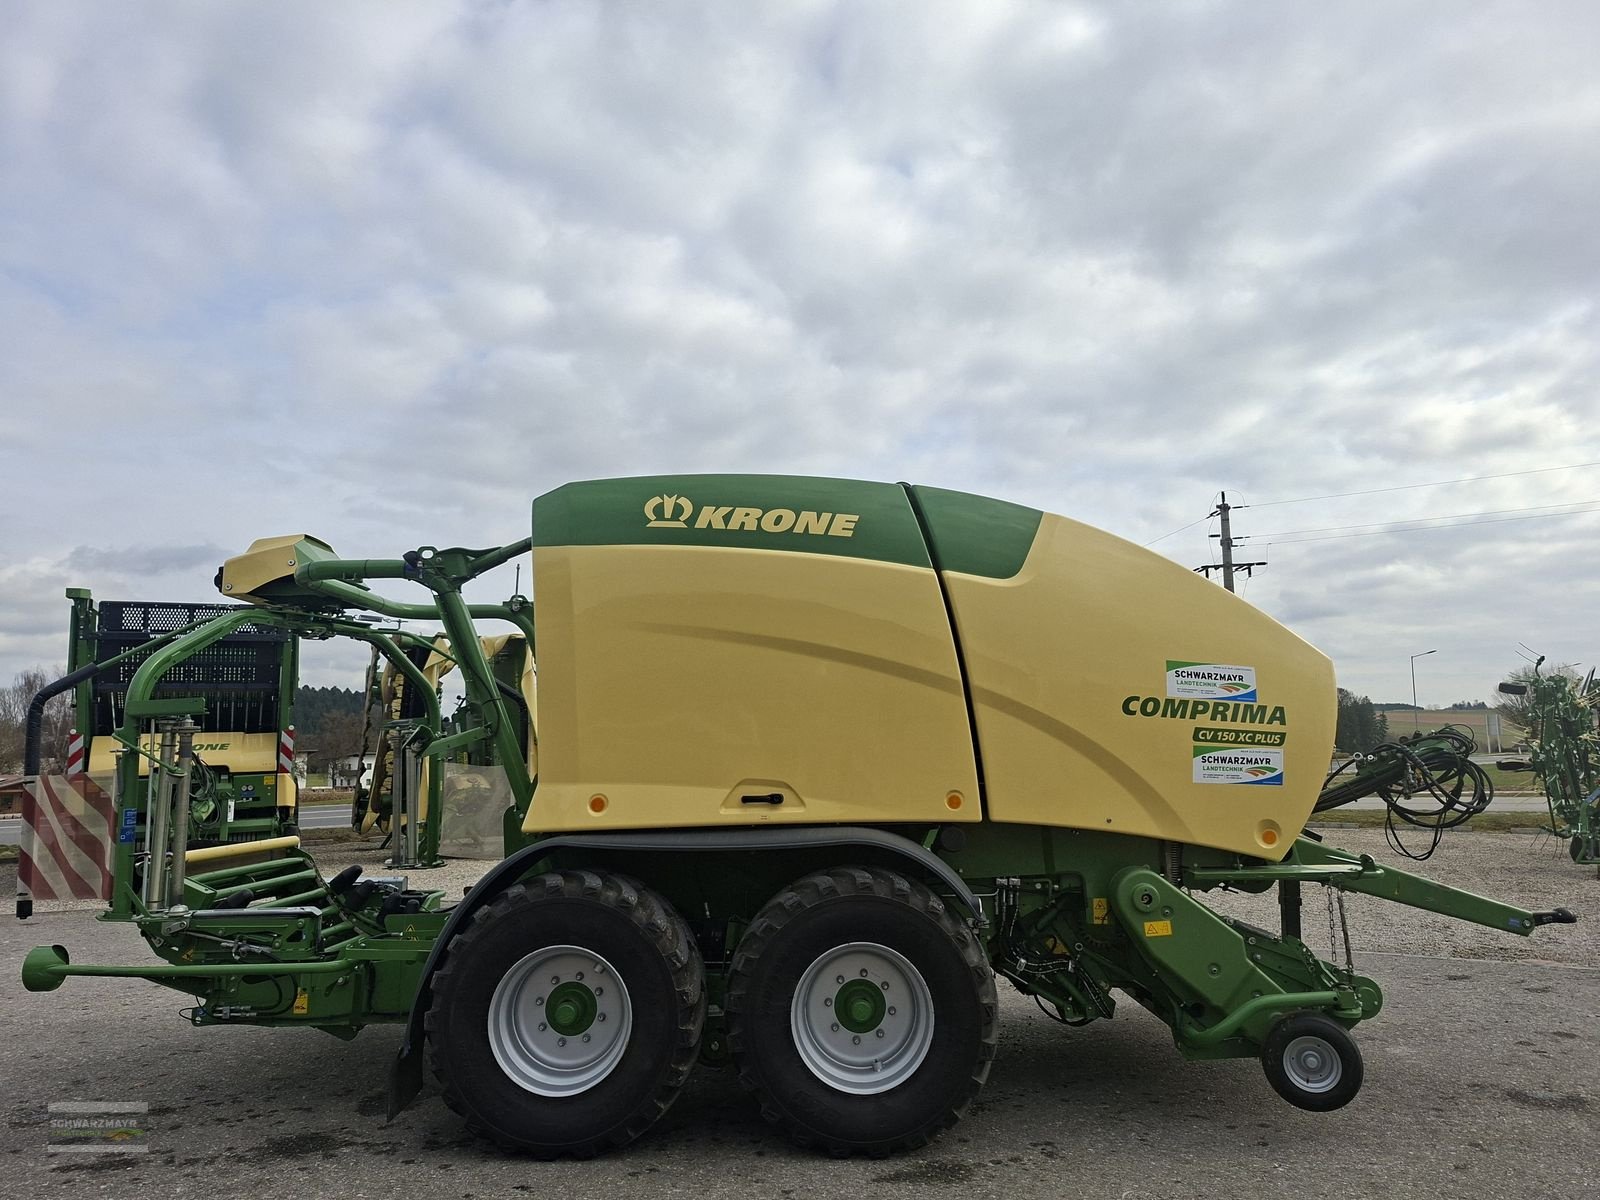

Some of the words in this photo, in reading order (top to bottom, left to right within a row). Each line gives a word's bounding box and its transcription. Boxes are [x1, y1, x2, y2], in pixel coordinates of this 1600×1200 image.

[694, 506, 860, 537] KRONE
[1174, 670, 1244, 682] SCHWARZMAYR
[1176, 680, 1218, 688] LANDTECHNIK
[1121, 695, 1286, 726] COMPRIMA
[1198, 730, 1214, 740] CV
[1217, 731, 1235, 742] 150
[1238, 732, 1254, 742] XC
[1254, 733, 1281, 744] PLUS
[1201, 755, 1271, 766] SCHWARZMAYR
[1202, 765, 1243, 773] LANDTECHNIK
